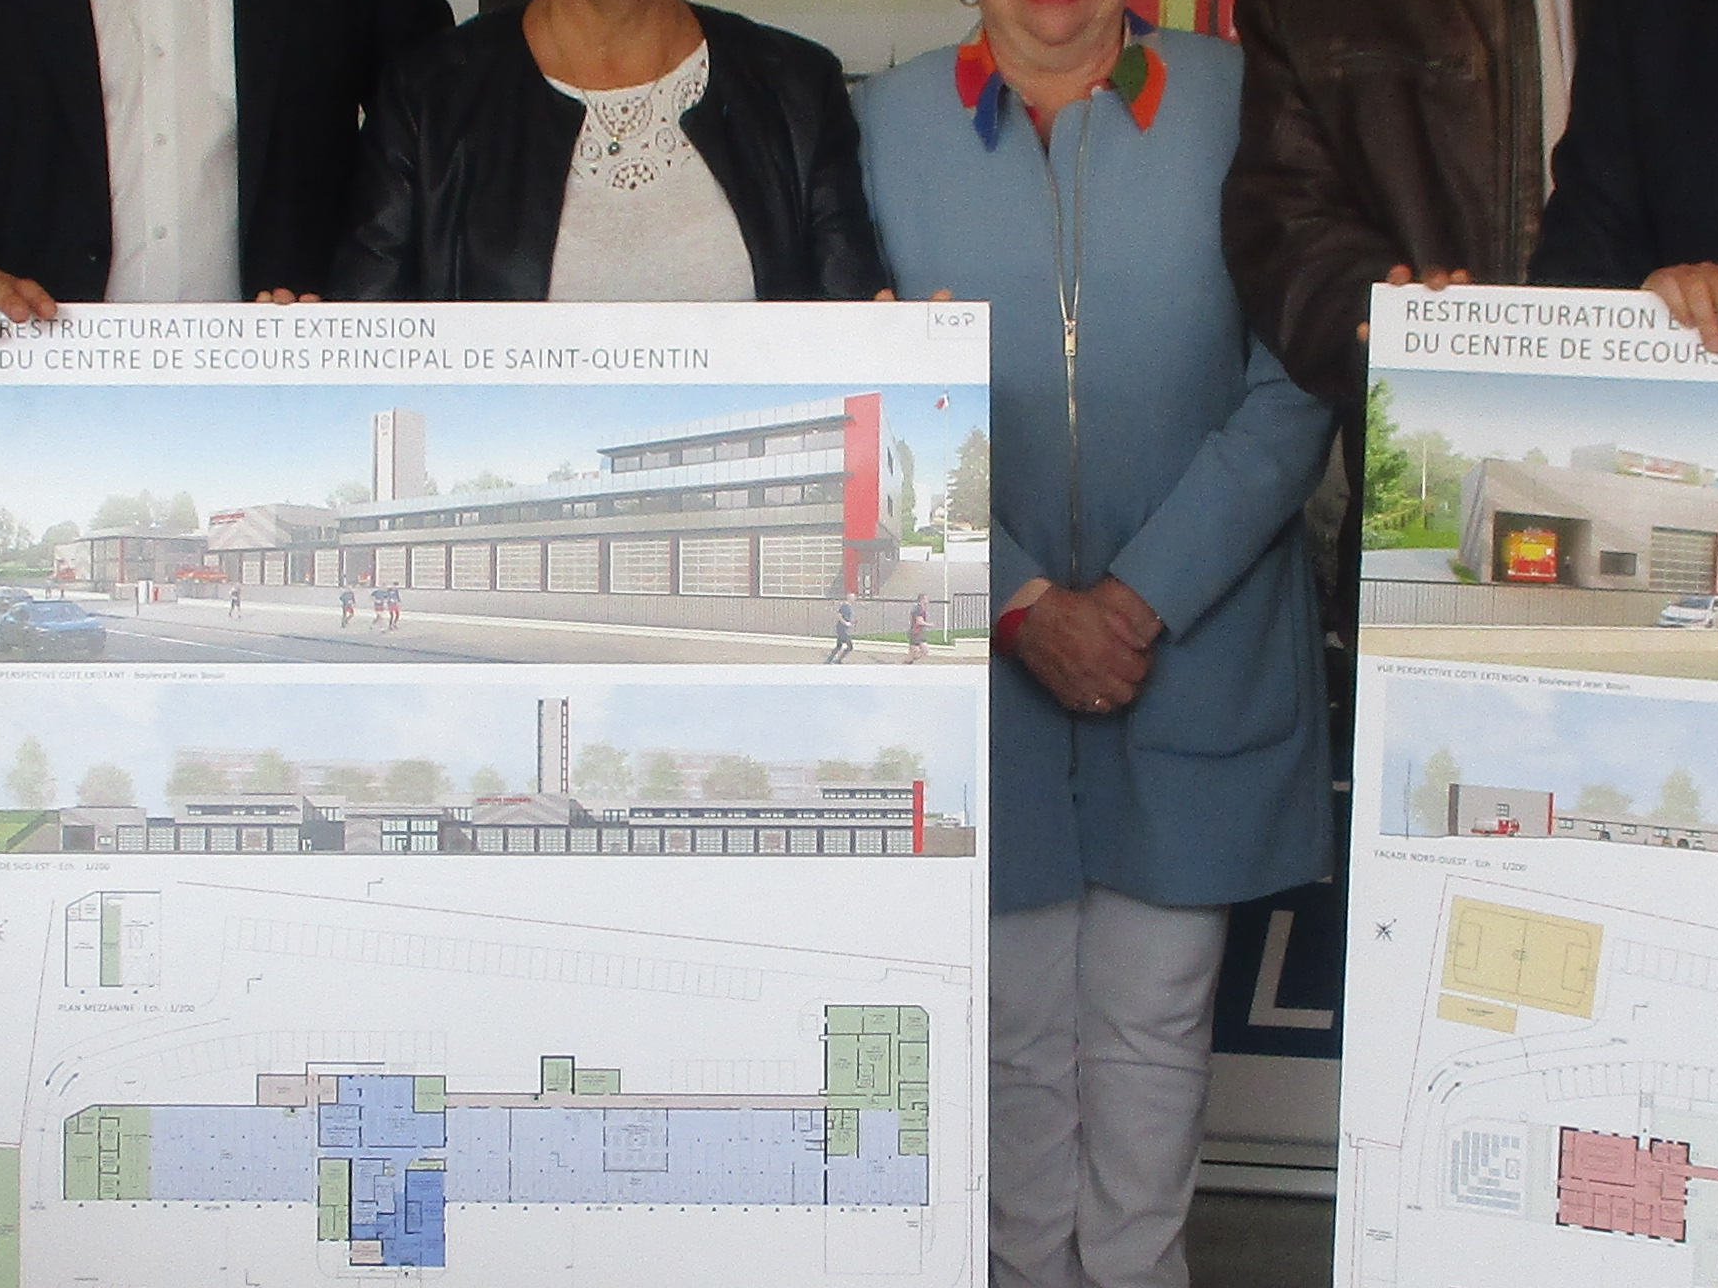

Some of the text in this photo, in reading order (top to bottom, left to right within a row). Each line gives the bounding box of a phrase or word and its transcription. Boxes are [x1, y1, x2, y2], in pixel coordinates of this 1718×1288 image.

[1405, 300, 1656, 330] RESTRUCTURATION
[256, 318, 283, 339] ET
[294, 318, 435, 338] EXTENSION
[44, 349, 141, 369] CENTRE
[153, 349, 183, 369] DE
[193, 349, 310, 369] SECOURS
[322, 349, 453, 369] PRINCIPAL
[464, 349, 495, 369] DE
[505, 348, 709, 370] SAINT-QUENTIN
[1404, 331, 1440, 354] DU
[1451, 333, 1548, 359] CENTRE
[1560, 338, 1591, 361] DE
